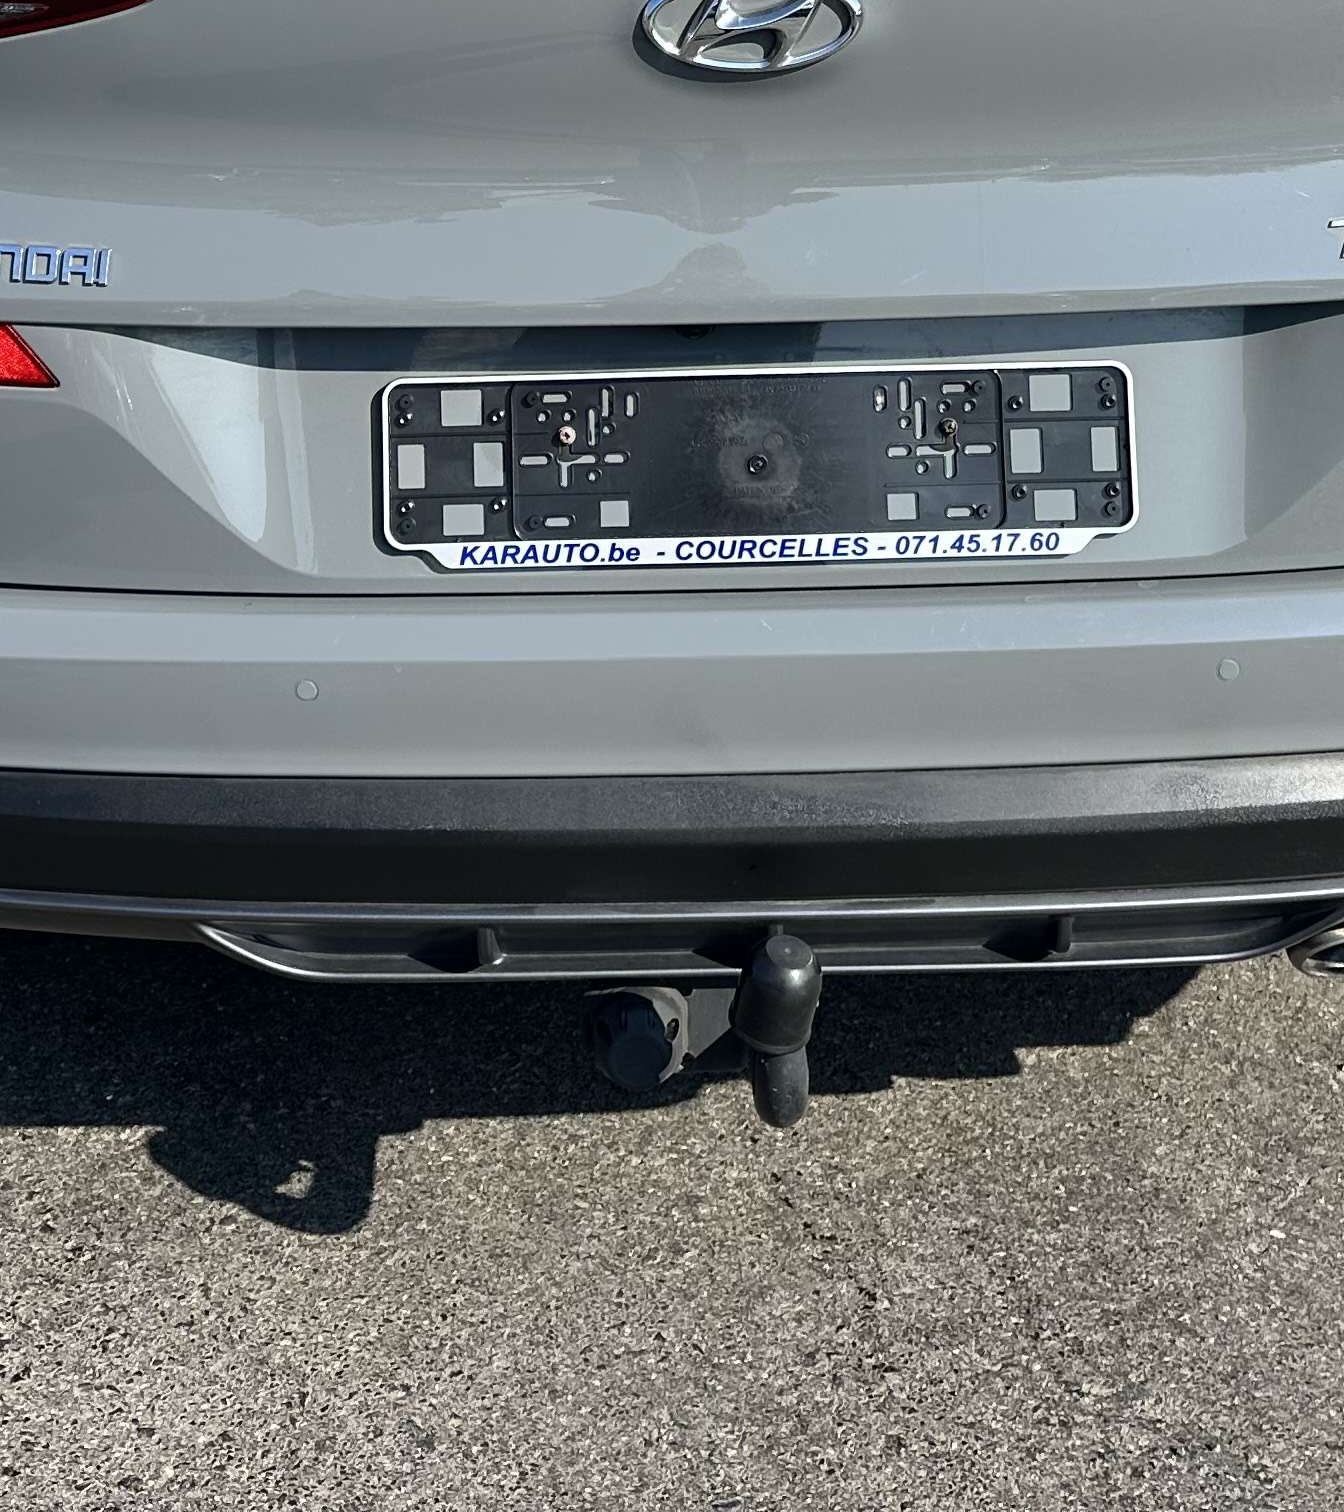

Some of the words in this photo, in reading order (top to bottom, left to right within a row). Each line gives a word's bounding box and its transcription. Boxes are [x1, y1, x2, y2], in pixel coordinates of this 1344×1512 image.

[459, 542, 641, 566] KARAUTO.be
[675, 536, 869, 561] COURCELLES
[895, 532, 1060, 555] 071.45.17.60
